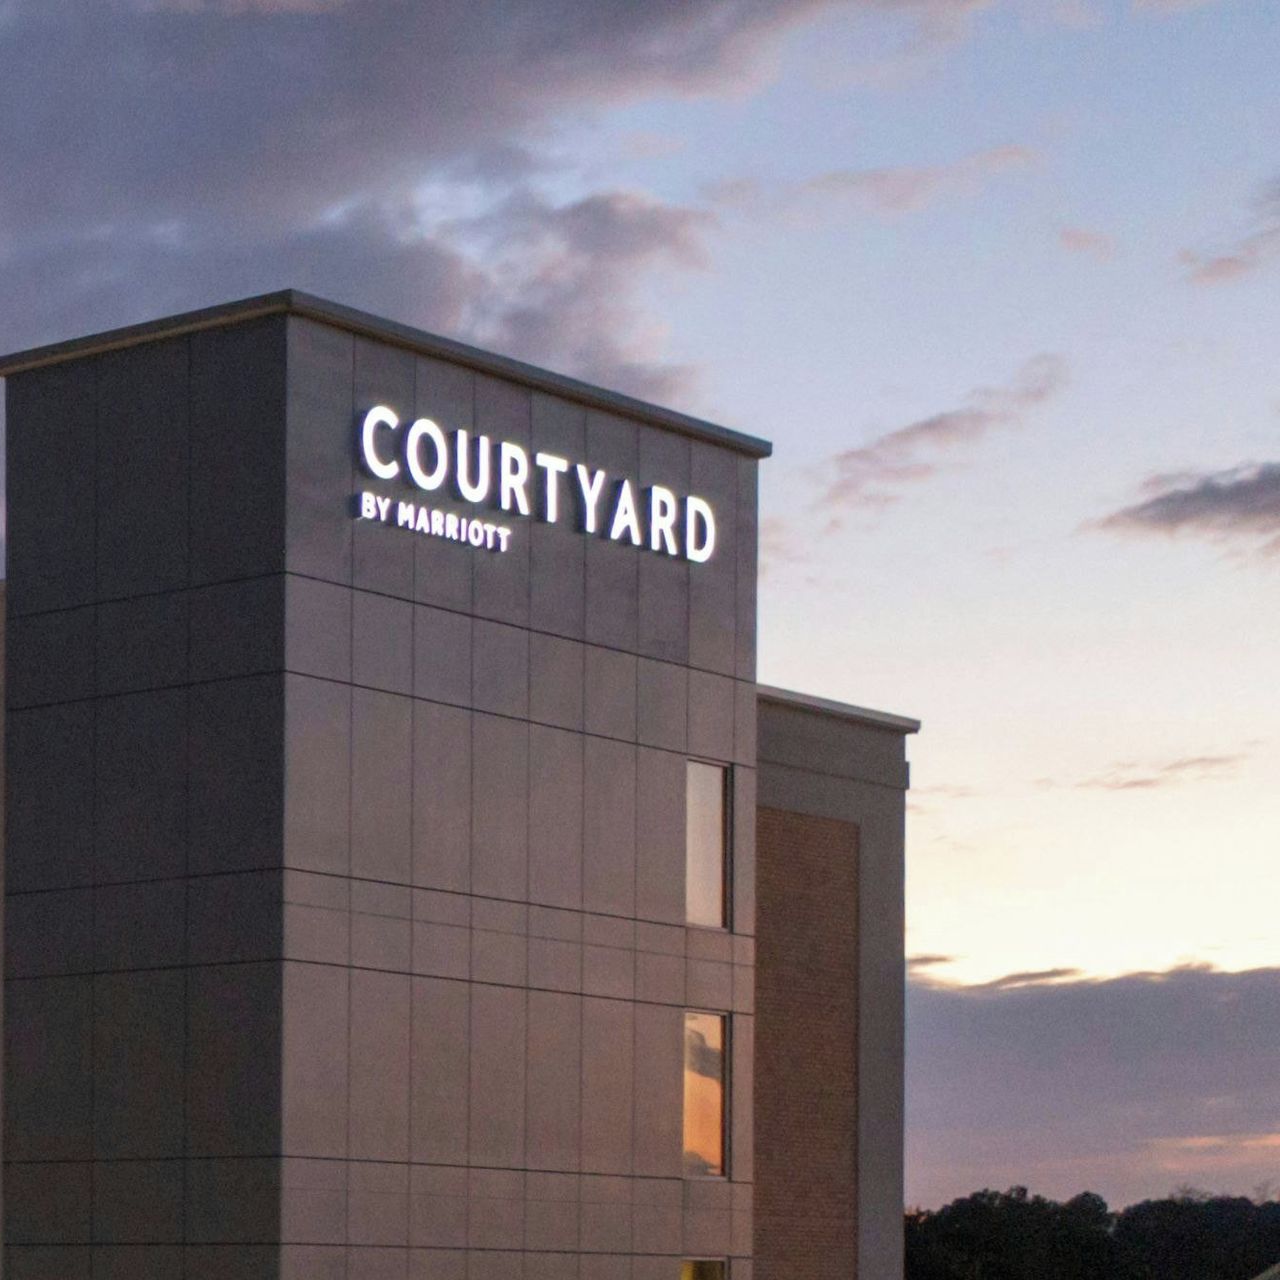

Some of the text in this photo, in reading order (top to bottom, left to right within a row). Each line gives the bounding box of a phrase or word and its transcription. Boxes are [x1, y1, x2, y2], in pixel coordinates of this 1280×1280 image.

[360, 491, 512, 553] BY MARRIOTT
[361, 404, 718, 563] COURTYARD
